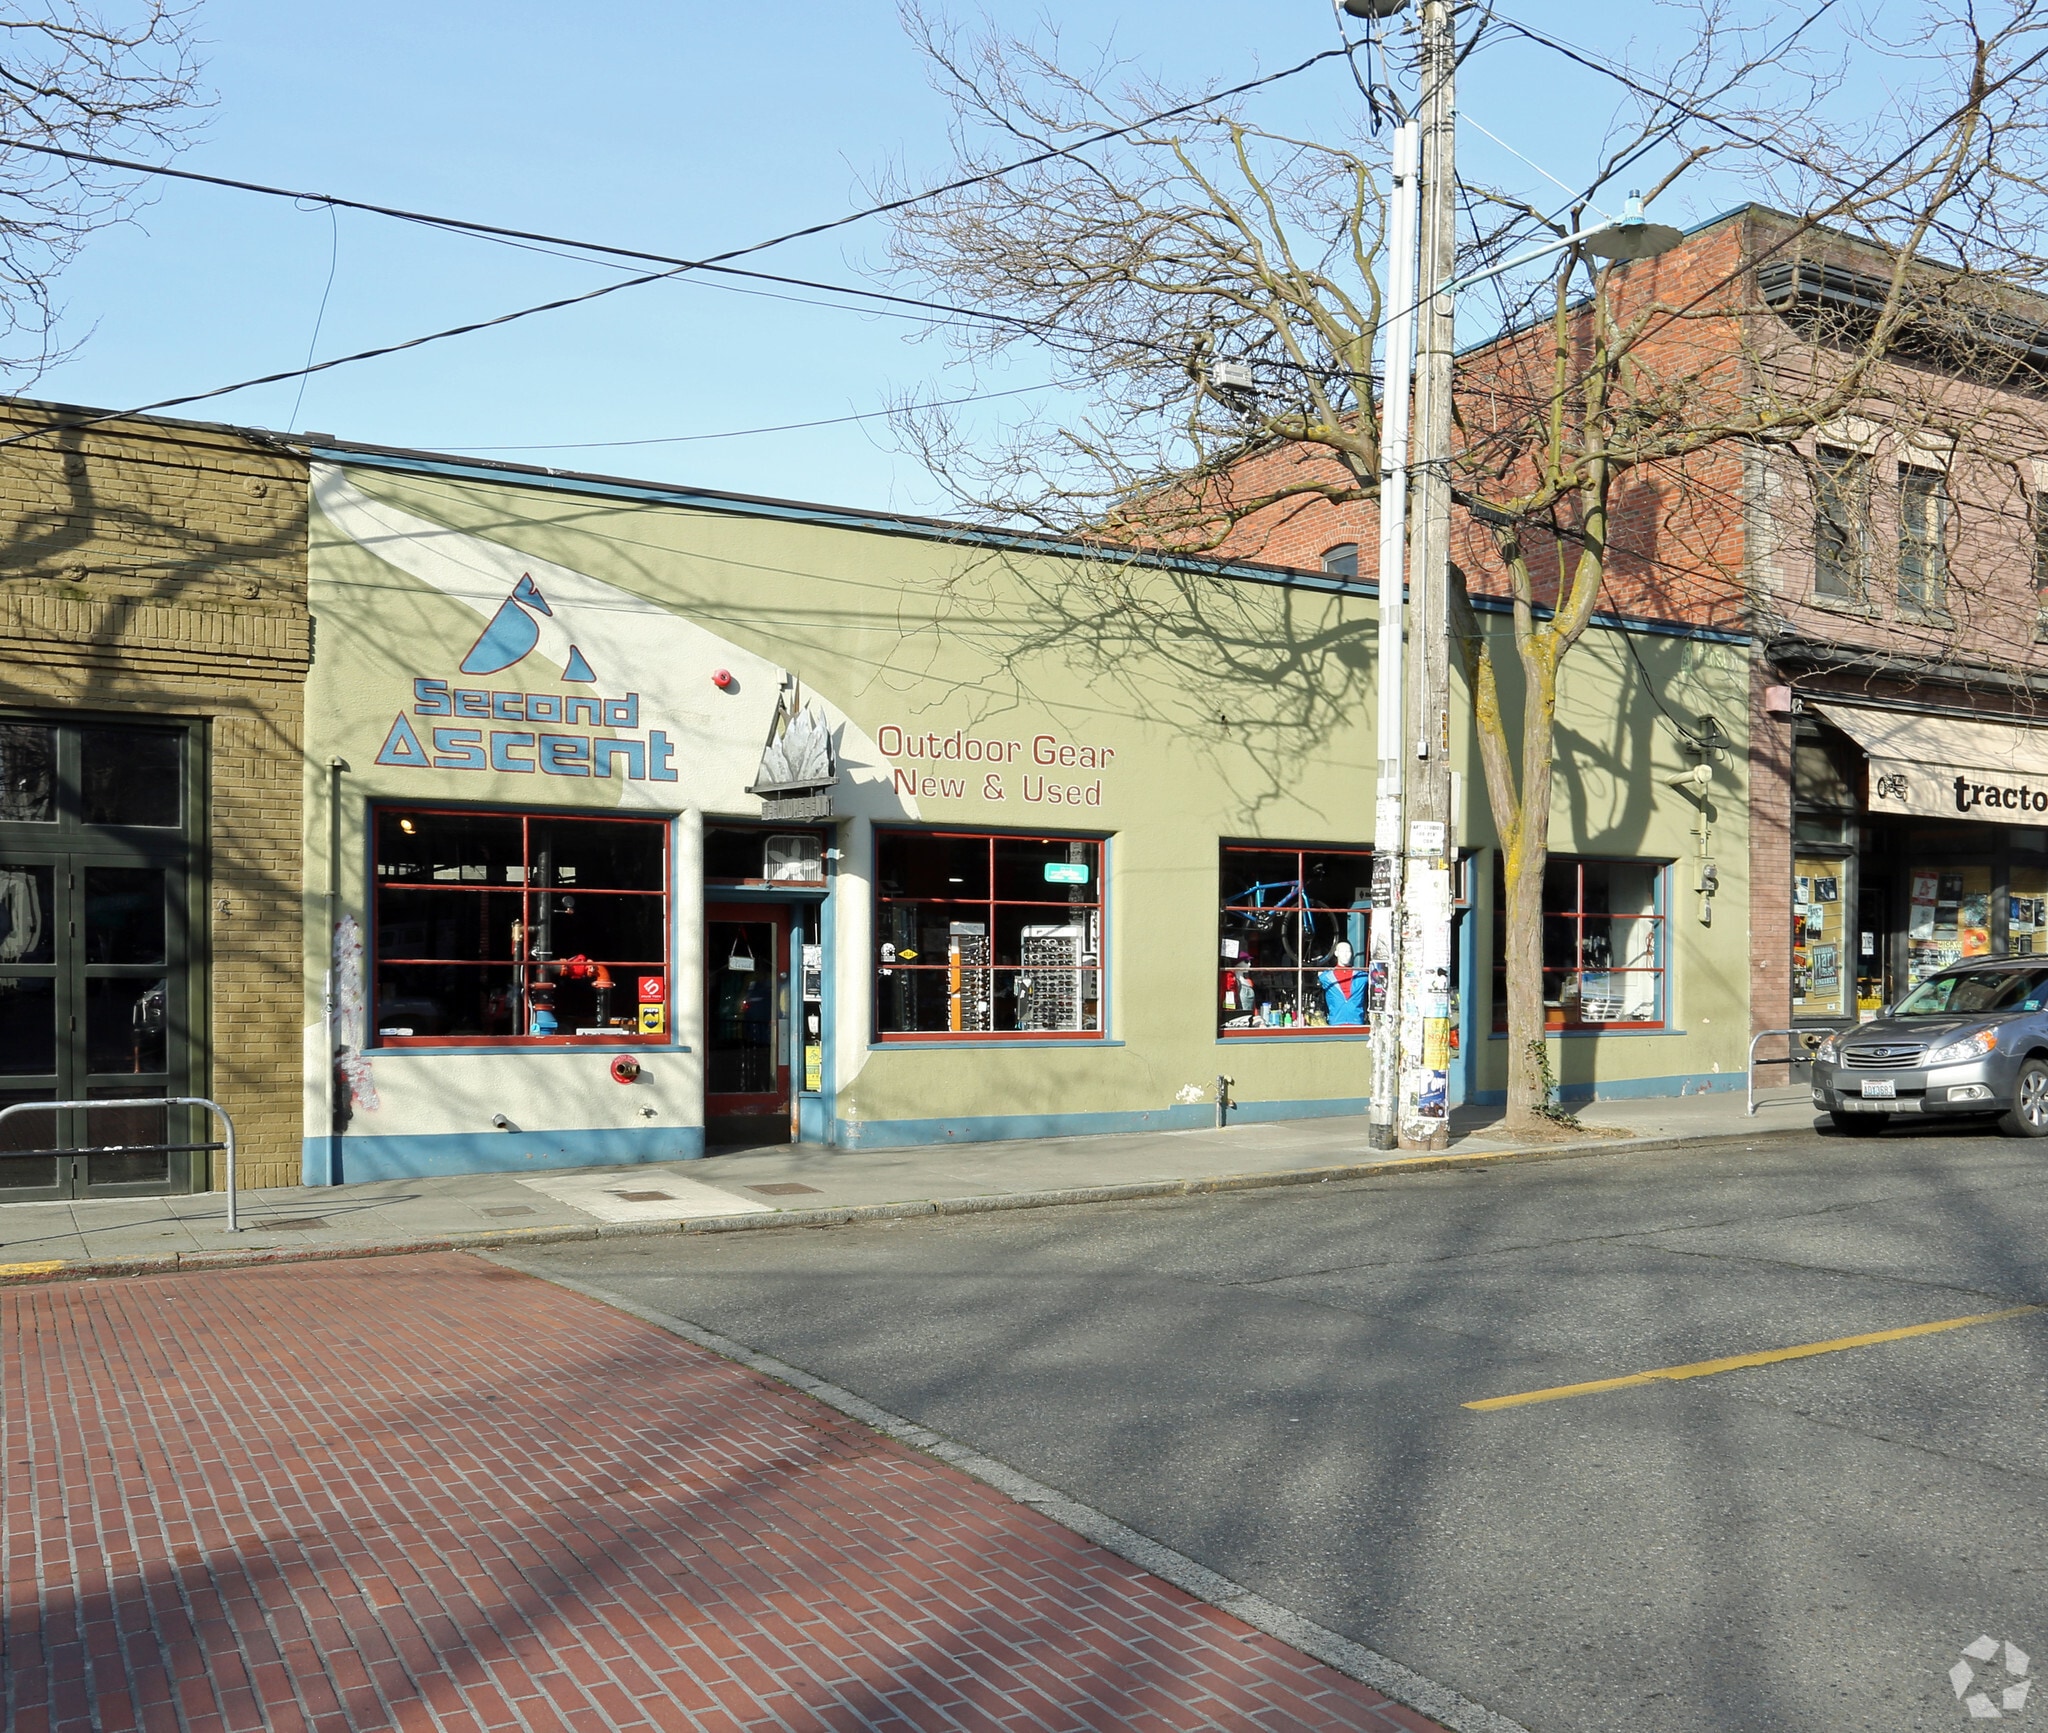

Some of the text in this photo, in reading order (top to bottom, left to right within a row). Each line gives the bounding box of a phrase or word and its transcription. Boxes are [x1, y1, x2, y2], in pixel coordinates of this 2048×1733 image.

[414, 677, 639, 729] Second
[374, 710, 678, 782] Ascent
[878, 725, 1115, 769] Outdoor Gear
[894, 768, 1102, 807] New & Used
